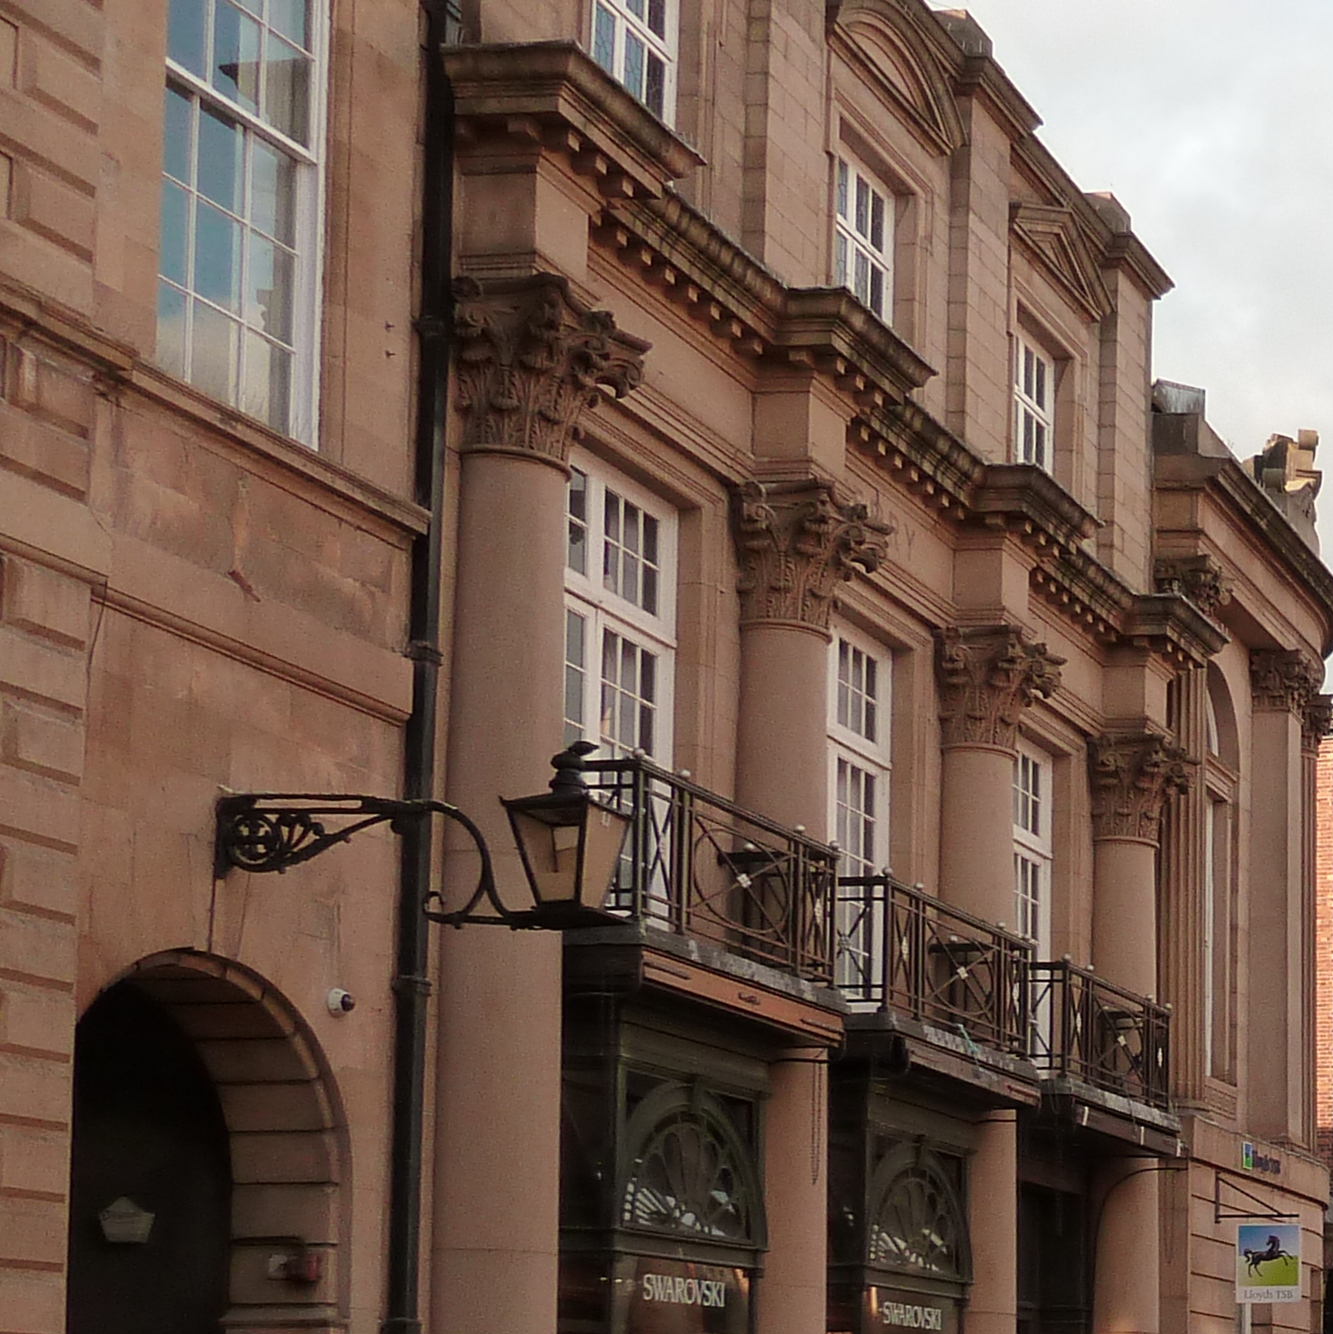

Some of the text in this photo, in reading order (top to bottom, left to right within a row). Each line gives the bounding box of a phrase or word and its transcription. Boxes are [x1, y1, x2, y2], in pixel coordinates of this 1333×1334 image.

[642, 1273, 726, 1308] SWAROVSKI
[1243, 1289, 1294, 1302] Lloyds TSB
[882, 1301, 942, 1331] SWAROVSKI
